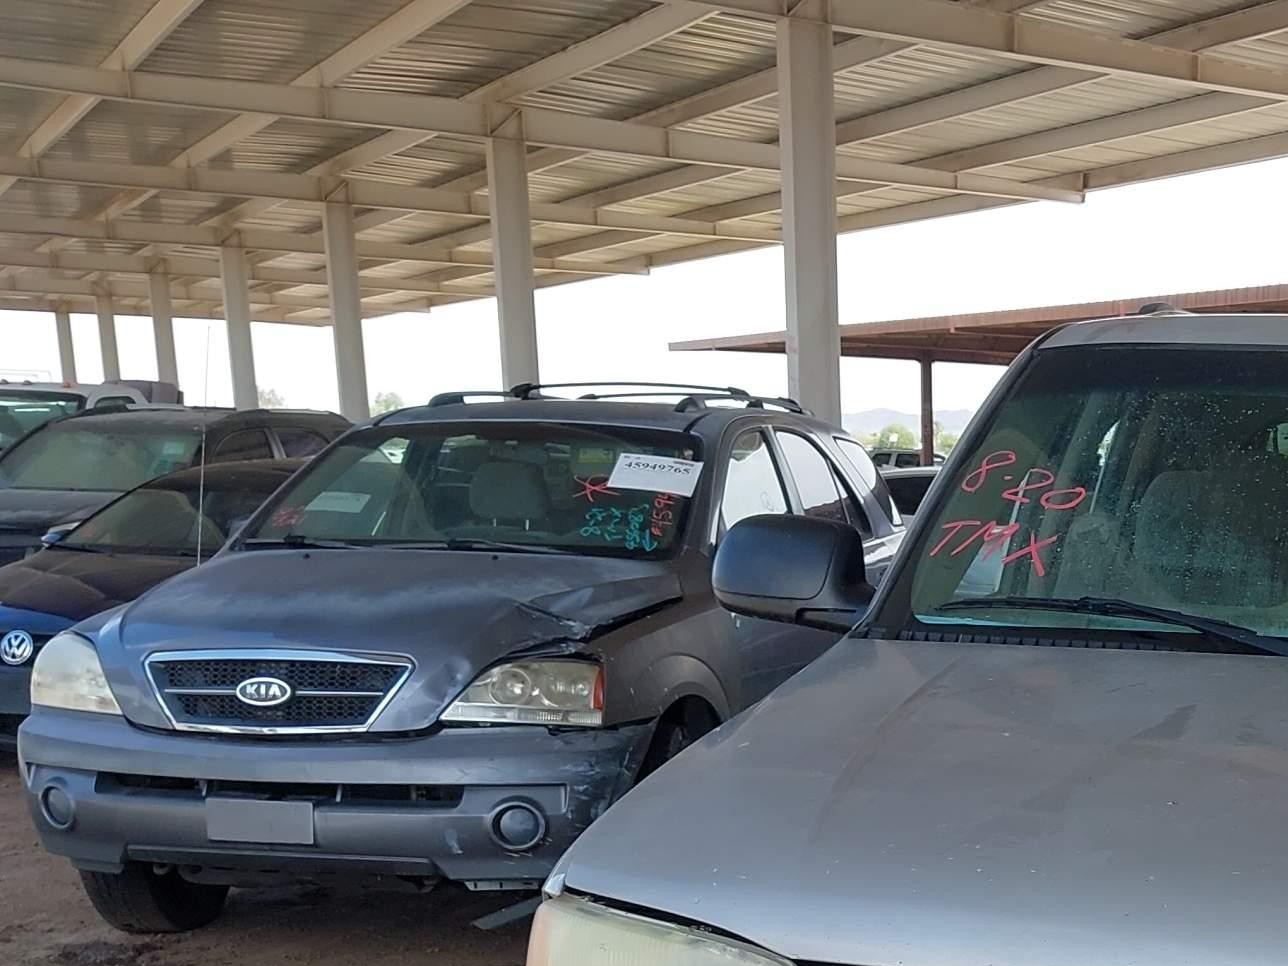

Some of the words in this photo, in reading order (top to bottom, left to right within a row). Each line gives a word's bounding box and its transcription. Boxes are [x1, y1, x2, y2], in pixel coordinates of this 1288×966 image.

[623, 461, 692, 475] 45949765
[2, 631, 31, 663] VW
[245, 684, 282, 699] KIA
